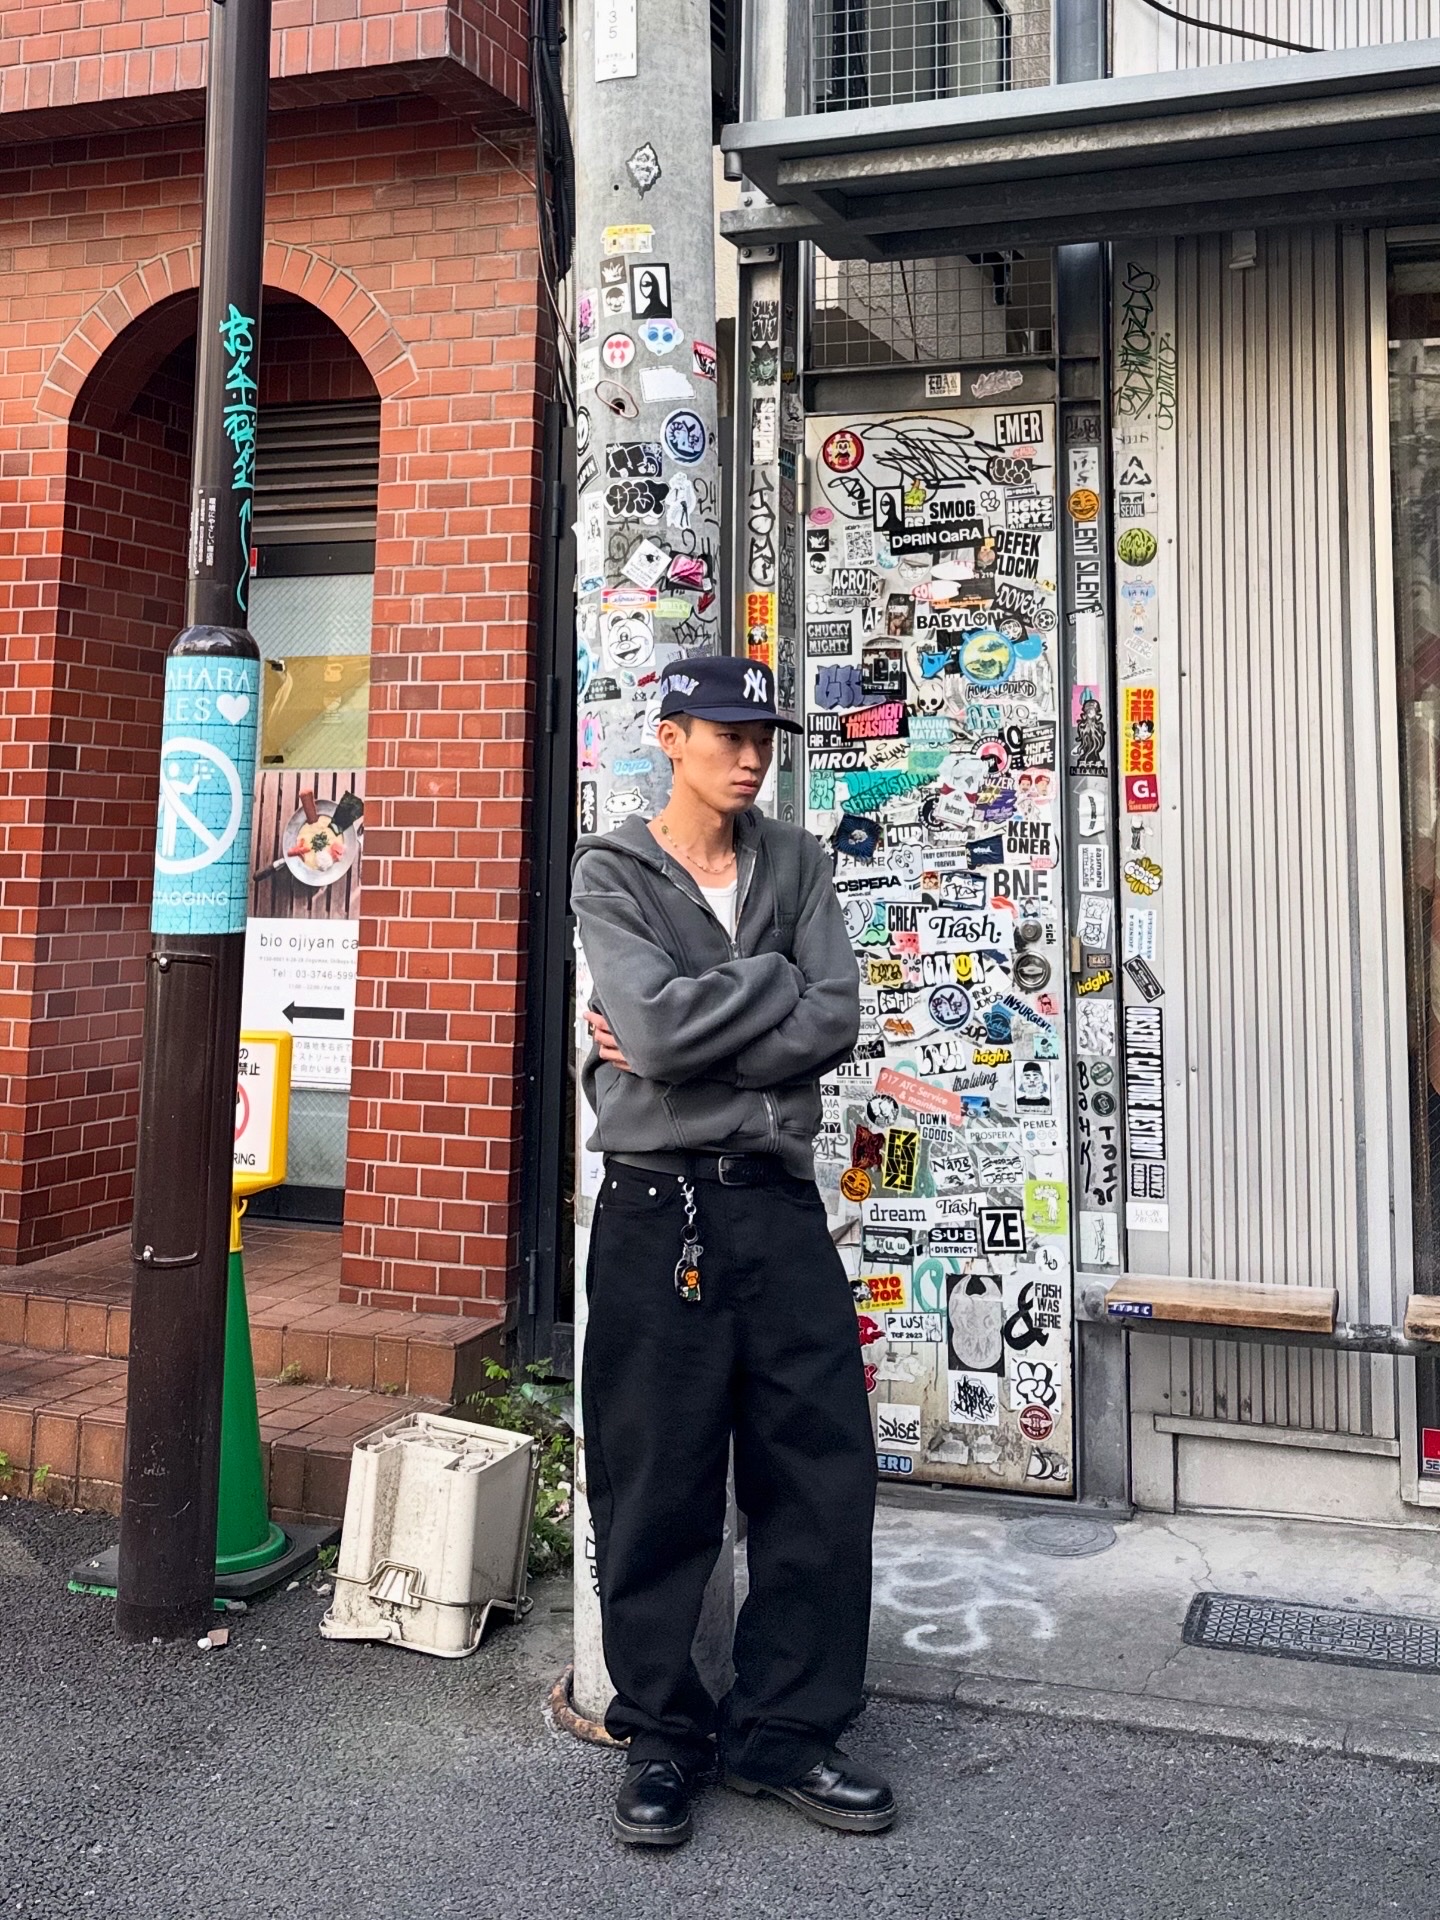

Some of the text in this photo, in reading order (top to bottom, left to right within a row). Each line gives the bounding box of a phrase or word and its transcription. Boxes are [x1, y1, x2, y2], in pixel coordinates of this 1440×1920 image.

[996, 412, 1042, 445] EMER
[929, 500, 975, 519] SMOG
[1120, 505, 1144, 517] SEOUL
[996, 530, 1041, 557] DEFEK
[998, 554, 1038, 580] LDCM
[807, 623, 850, 638] CHUCKY
[808, 639, 849, 653] MIGHTY
[743, 668, 768, 703] NY
[846, 719, 899, 739] TREASURE
[1008, 820, 1052, 839] KENT
[1007, 838, 1051, 856] ONER
[833, 875, 901, 893] OSPERA
[260, 933, 283, 948] bio
[289, 934, 335, 952] ojiyan
[295, 970, 355, 980] 03-3746-599
[1126, 1007, 1161, 1055] OBSERVE
[881, 1072, 899, 1085] 917
[916, 1086, 948, 1105] Service
[1127, 1057, 1162, 1107] CAPTURE
[898, 1091, 906, 1100] &
[919, 1113, 947, 1125] DOWN
[1023, 1120, 1057, 1129] PEMEX
[922, 1127, 953, 1143] GOODS
[1128, 1108, 1164, 1159] DESTROY
[1132, 1164, 1146, 1196] KIRBY
[1150, 1165, 1163, 1198] ZAKU
[870, 1203, 927, 1222] dream
[935, 1199, 980, 1217] Trash
[985, 1212, 1021, 1248] ZE
[934, 1246, 973, 1254] DISTRICT
[867, 1276, 901, 1291] RYO
[1034, 1282, 1061, 1299] FOSH
[871, 1288, 903, 1303] YOK
[1037, 1298, 1059, 1312] WAS
[1034, 1312, 1061, 1329] HERE
